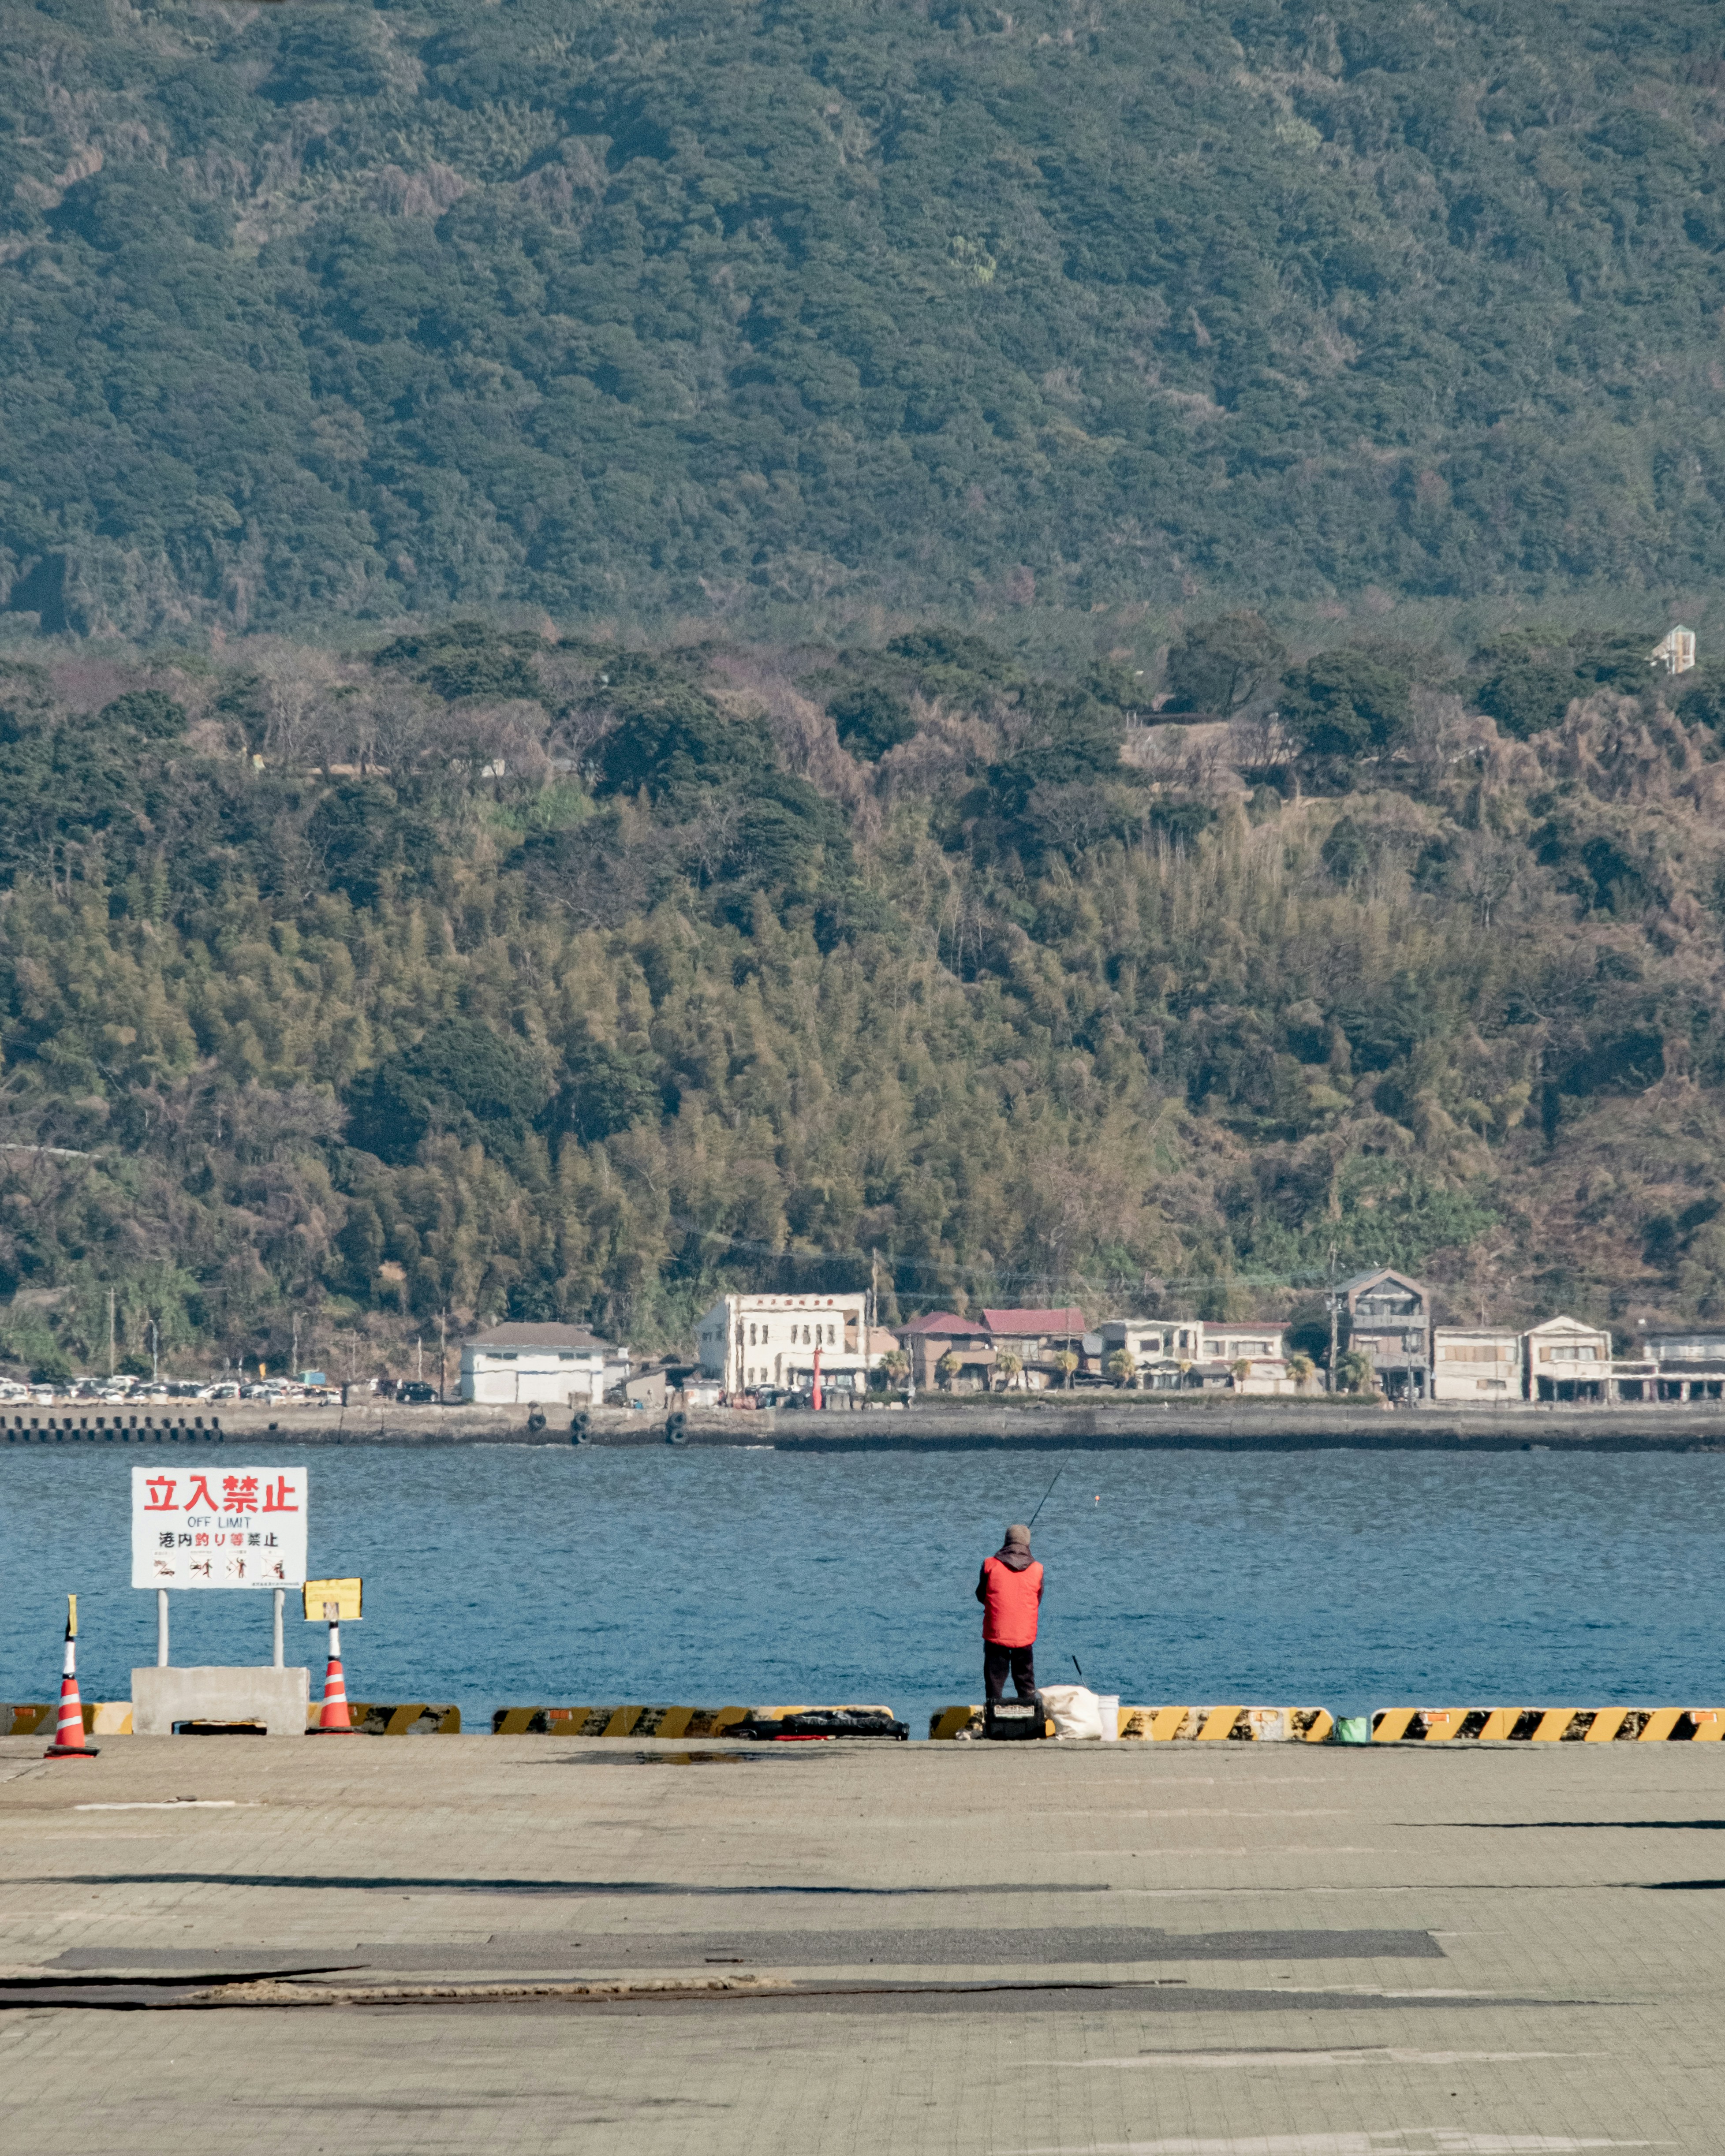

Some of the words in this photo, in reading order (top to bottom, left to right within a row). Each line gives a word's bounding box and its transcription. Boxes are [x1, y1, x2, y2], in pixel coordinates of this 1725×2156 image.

[144, 1475, 299, 1513] 立入禁止
[188, 1517, 211, 1528] OFF
[218, 1517, 251, 1529] LIMIT
[159, 1532, 278, 1548] 港内釣り等禁止
